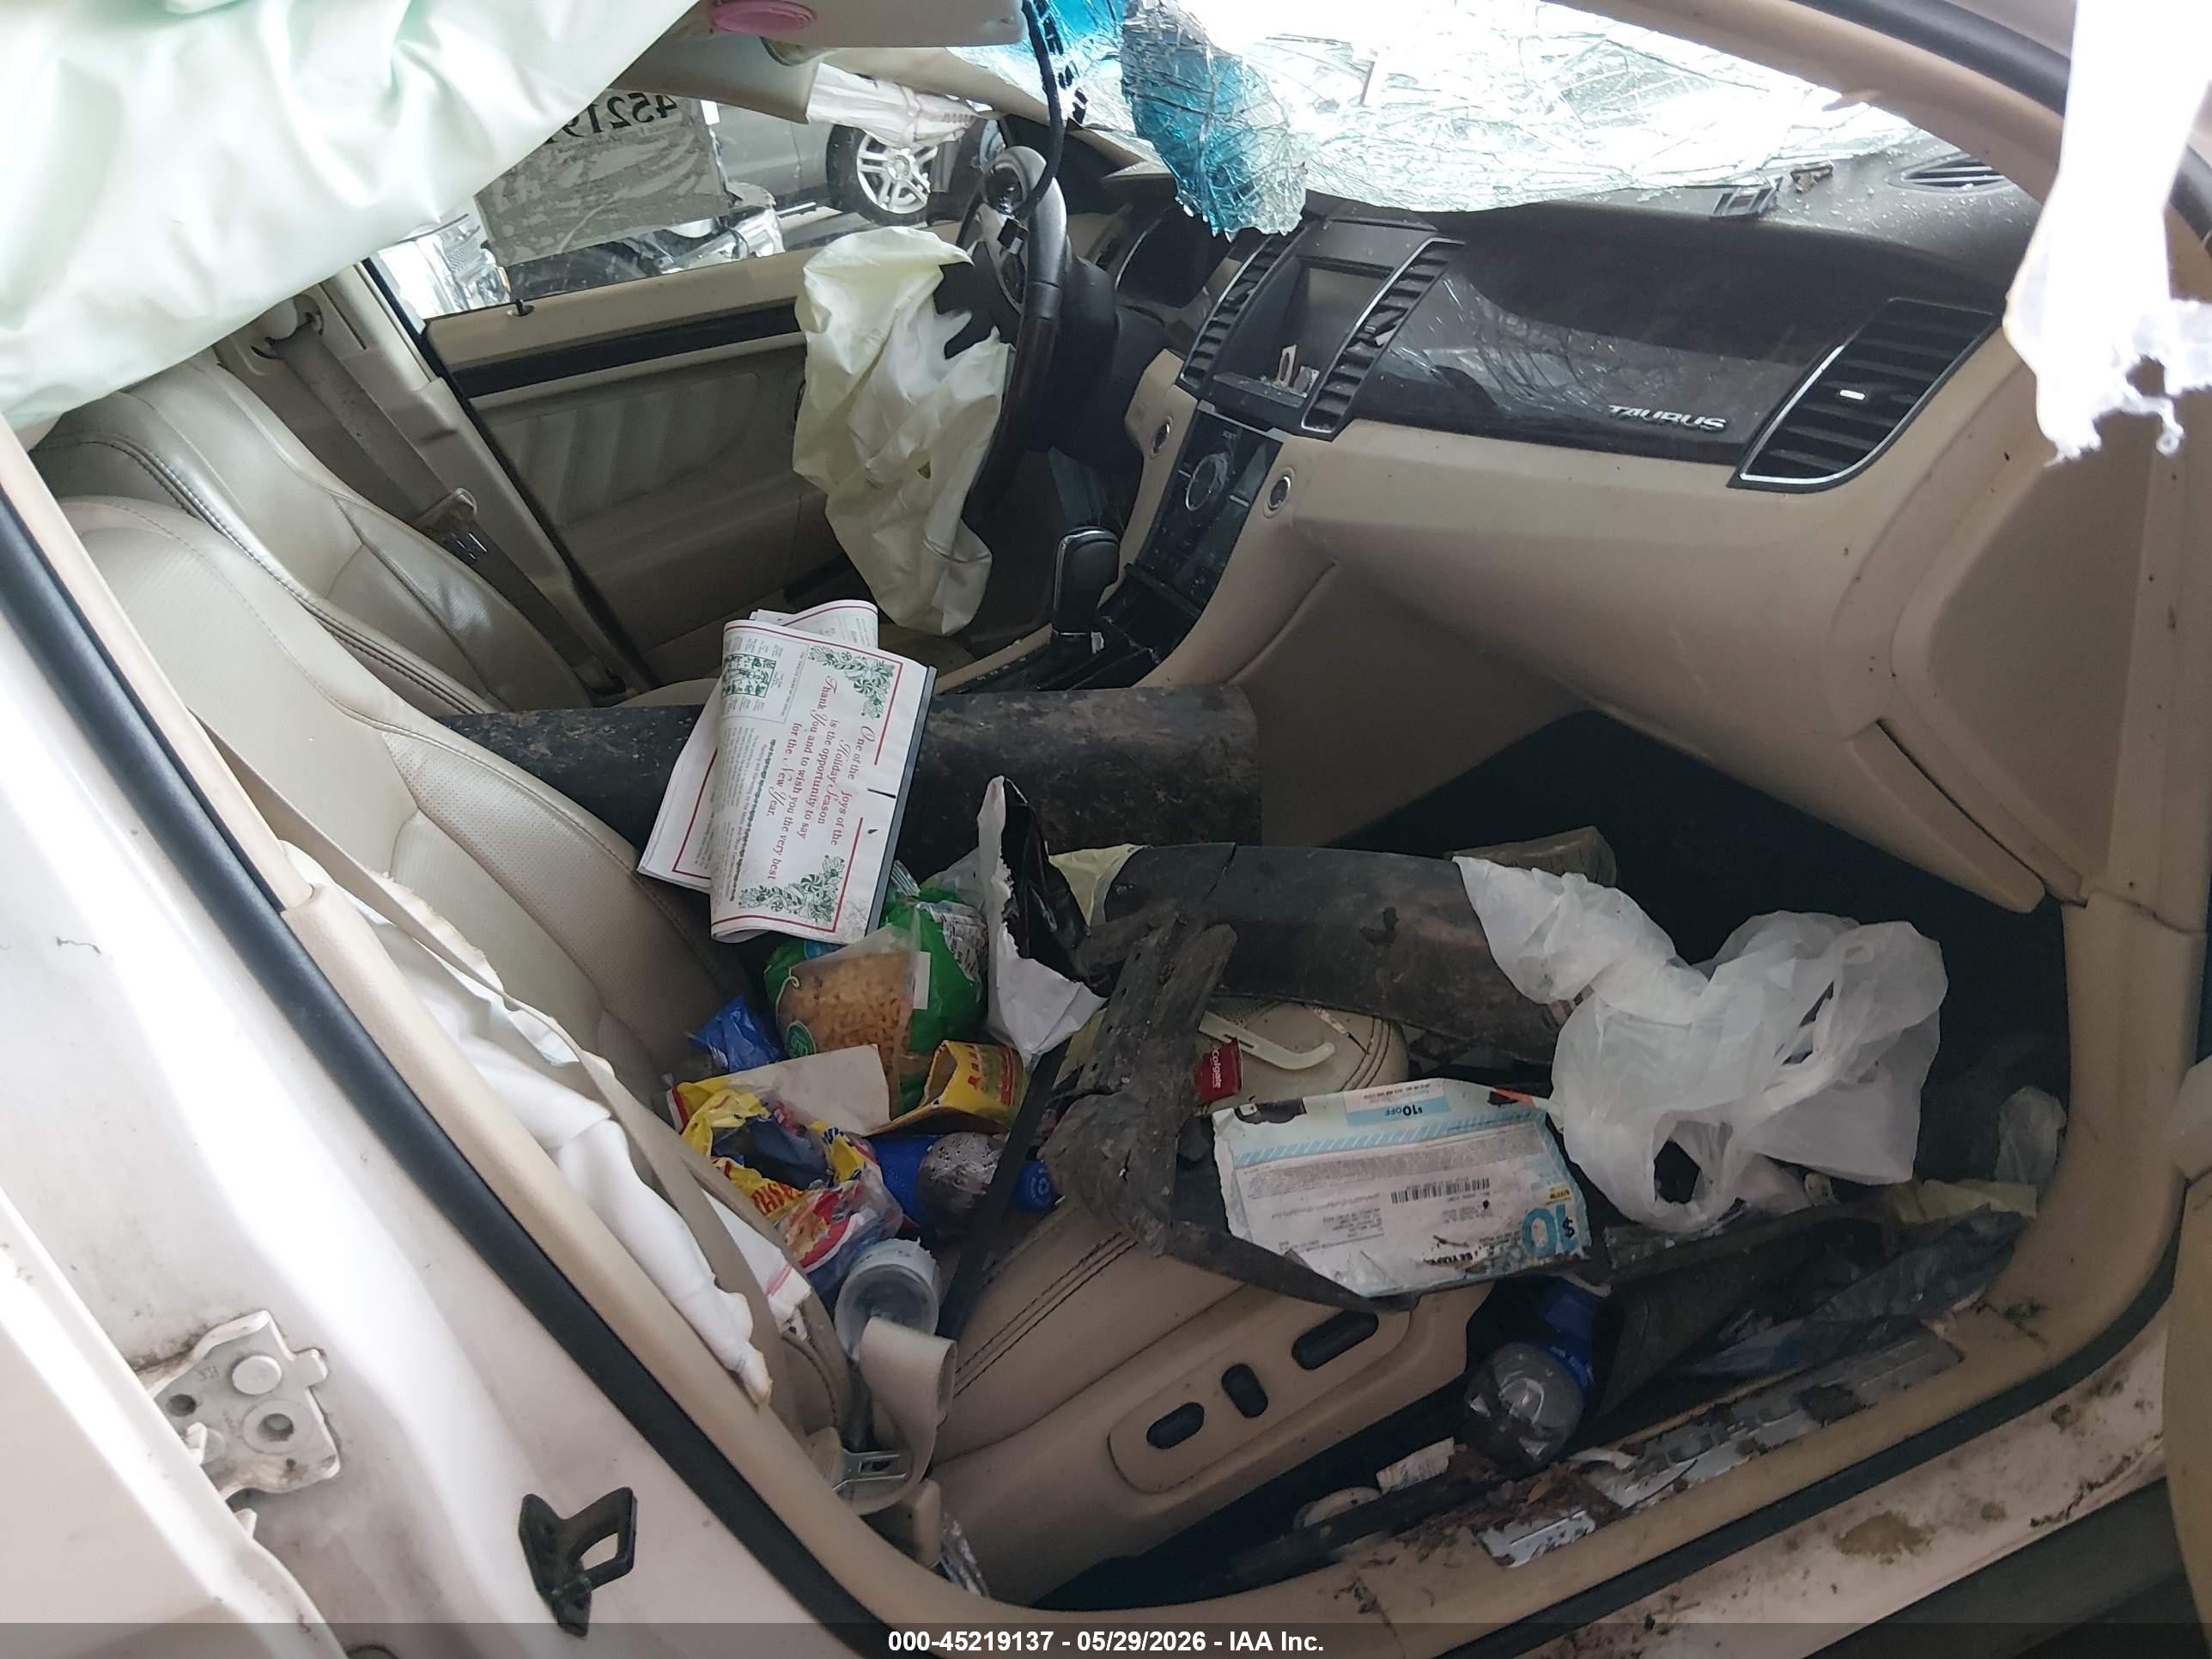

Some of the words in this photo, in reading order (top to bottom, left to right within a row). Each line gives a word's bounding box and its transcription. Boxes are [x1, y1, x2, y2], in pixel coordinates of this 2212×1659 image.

[1608, 404, 1727, 431] TAURUS
[817, 676, 838, 710] Thank
[791, 722, 802, 737] for
[810, 709, 829, 733] You
[830, 720, 840, 728] is
[785, 738, 797, 755] the
[804, 735, 816, 754] and
[824, 731, 836, 746] the
[855, 726, 876, 751] One
[800, 757, 811, 768] to
[827, 739, 851, 784] Holiday
[852, 753, 862, 764] of
[776, 757, 795, 787] New
[805, 748, 830, 808] opportunity
[848, 764, 860, 781] the
[793, 769, 805, 794] wish
[787, 795, 799, 813] you
[817, 783, 839, 824] Season
[804, 810, 814, 820] to
[836, 817, 845, 828] of
[781, 816, 793, 833] the
[797, 822, 809, 839] say
[773, 835, 787, 855] very
[831, 830, 842, 846] the
[768, 858, 782, 880] best
[1212, 1049, 1222, 1089] Colgate
[1385, 1106, 1402, 1116] OFF
[1403, 1103, 1423, 1117] $10
